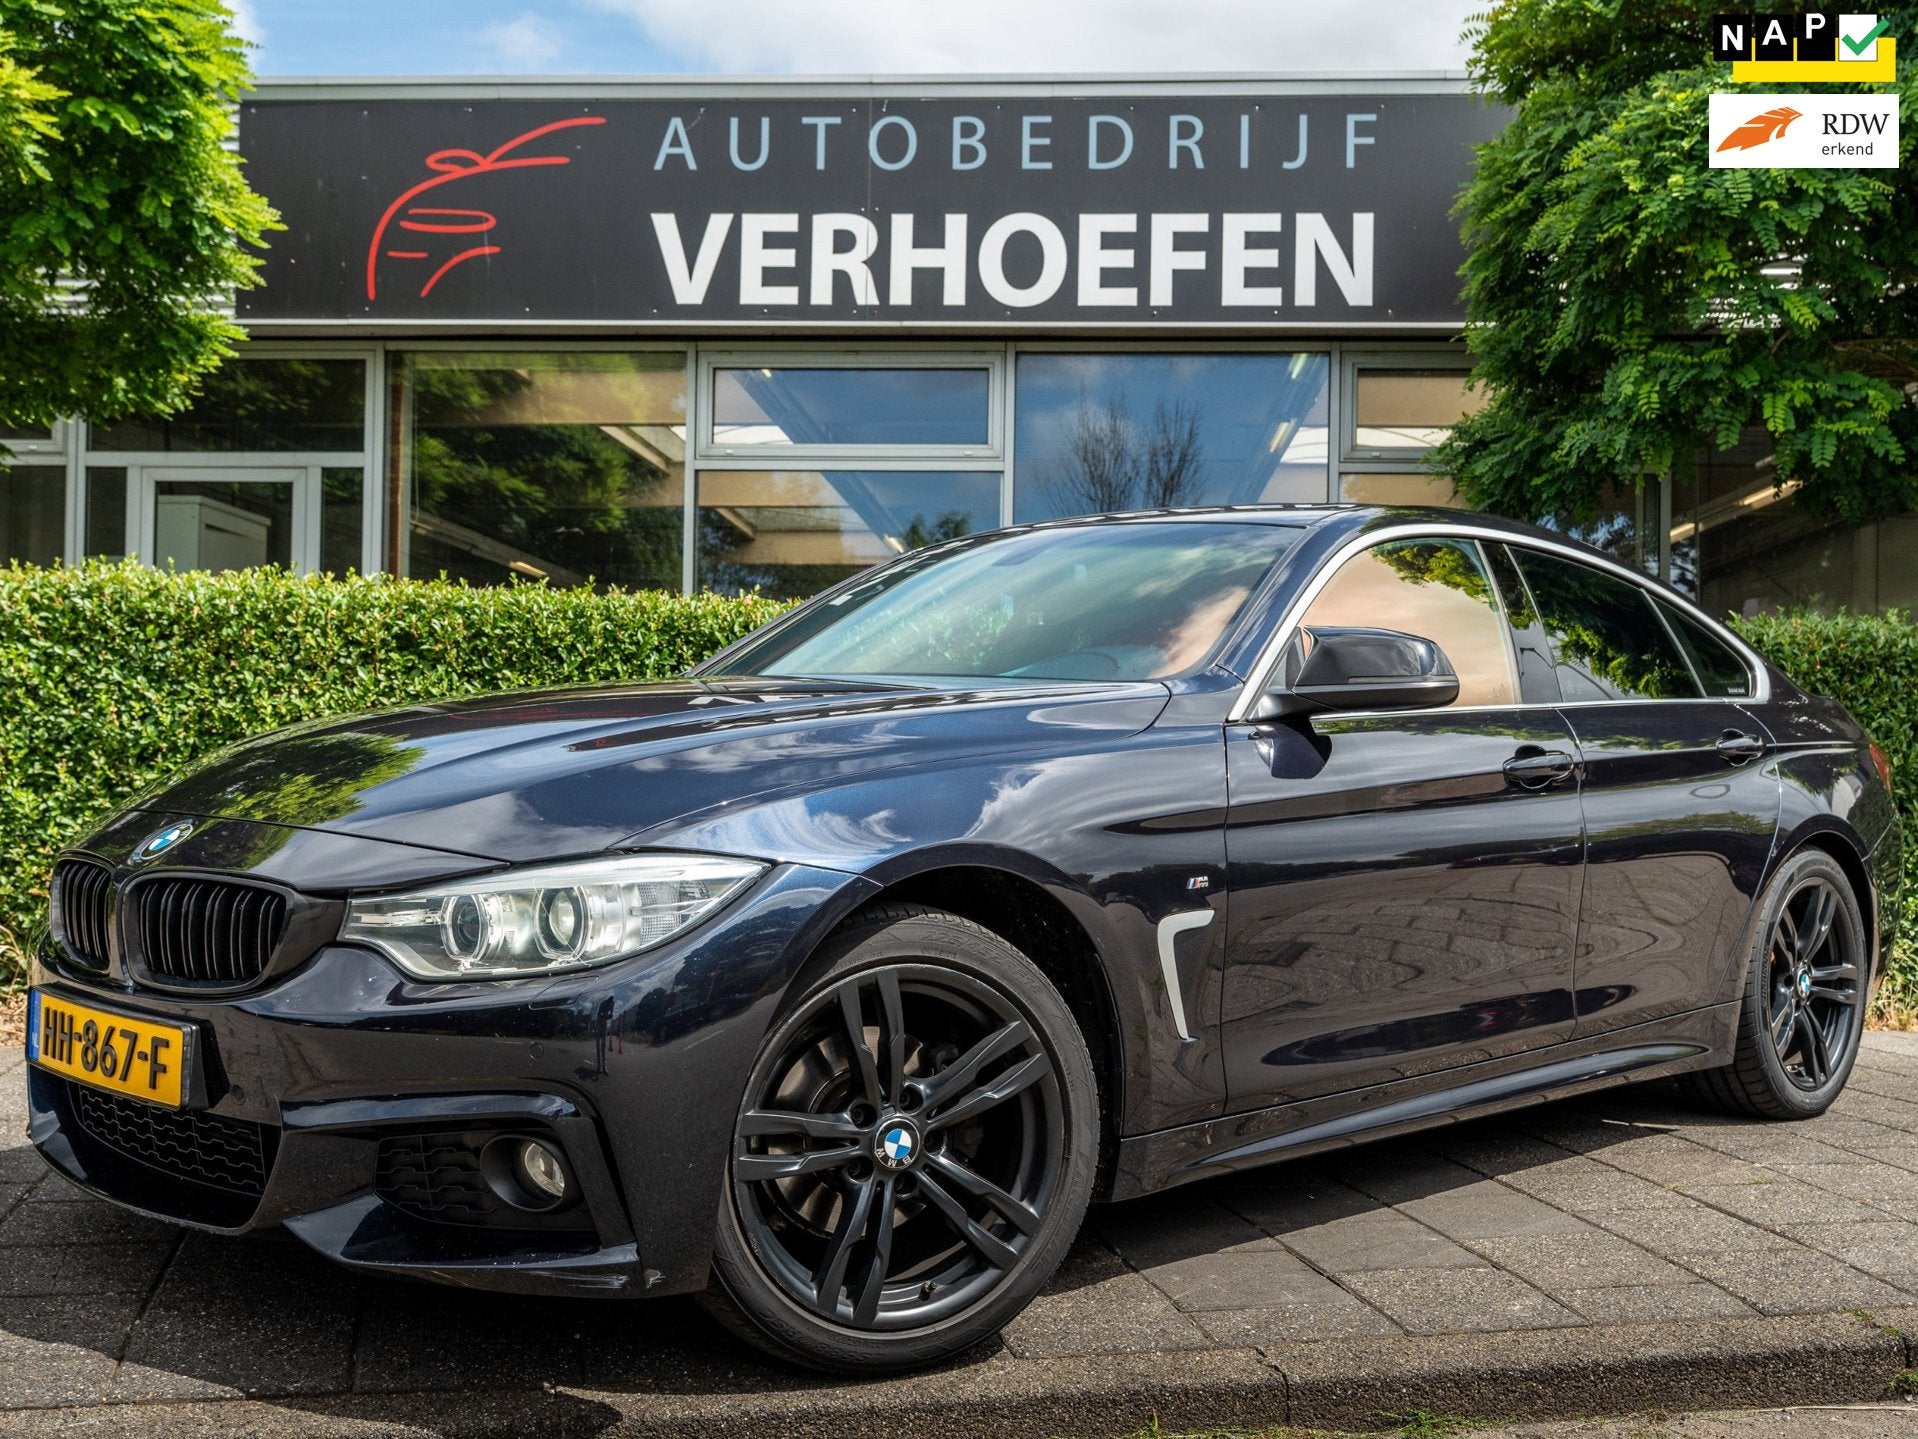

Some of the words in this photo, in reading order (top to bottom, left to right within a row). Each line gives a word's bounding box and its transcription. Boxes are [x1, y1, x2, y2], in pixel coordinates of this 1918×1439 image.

[652, 113, 1379, 172] AUTOBEDRIJF
[650, 210, 1376, 309] VERHOEFEN
[43, 1006, 170, 1090] HH-867-F
